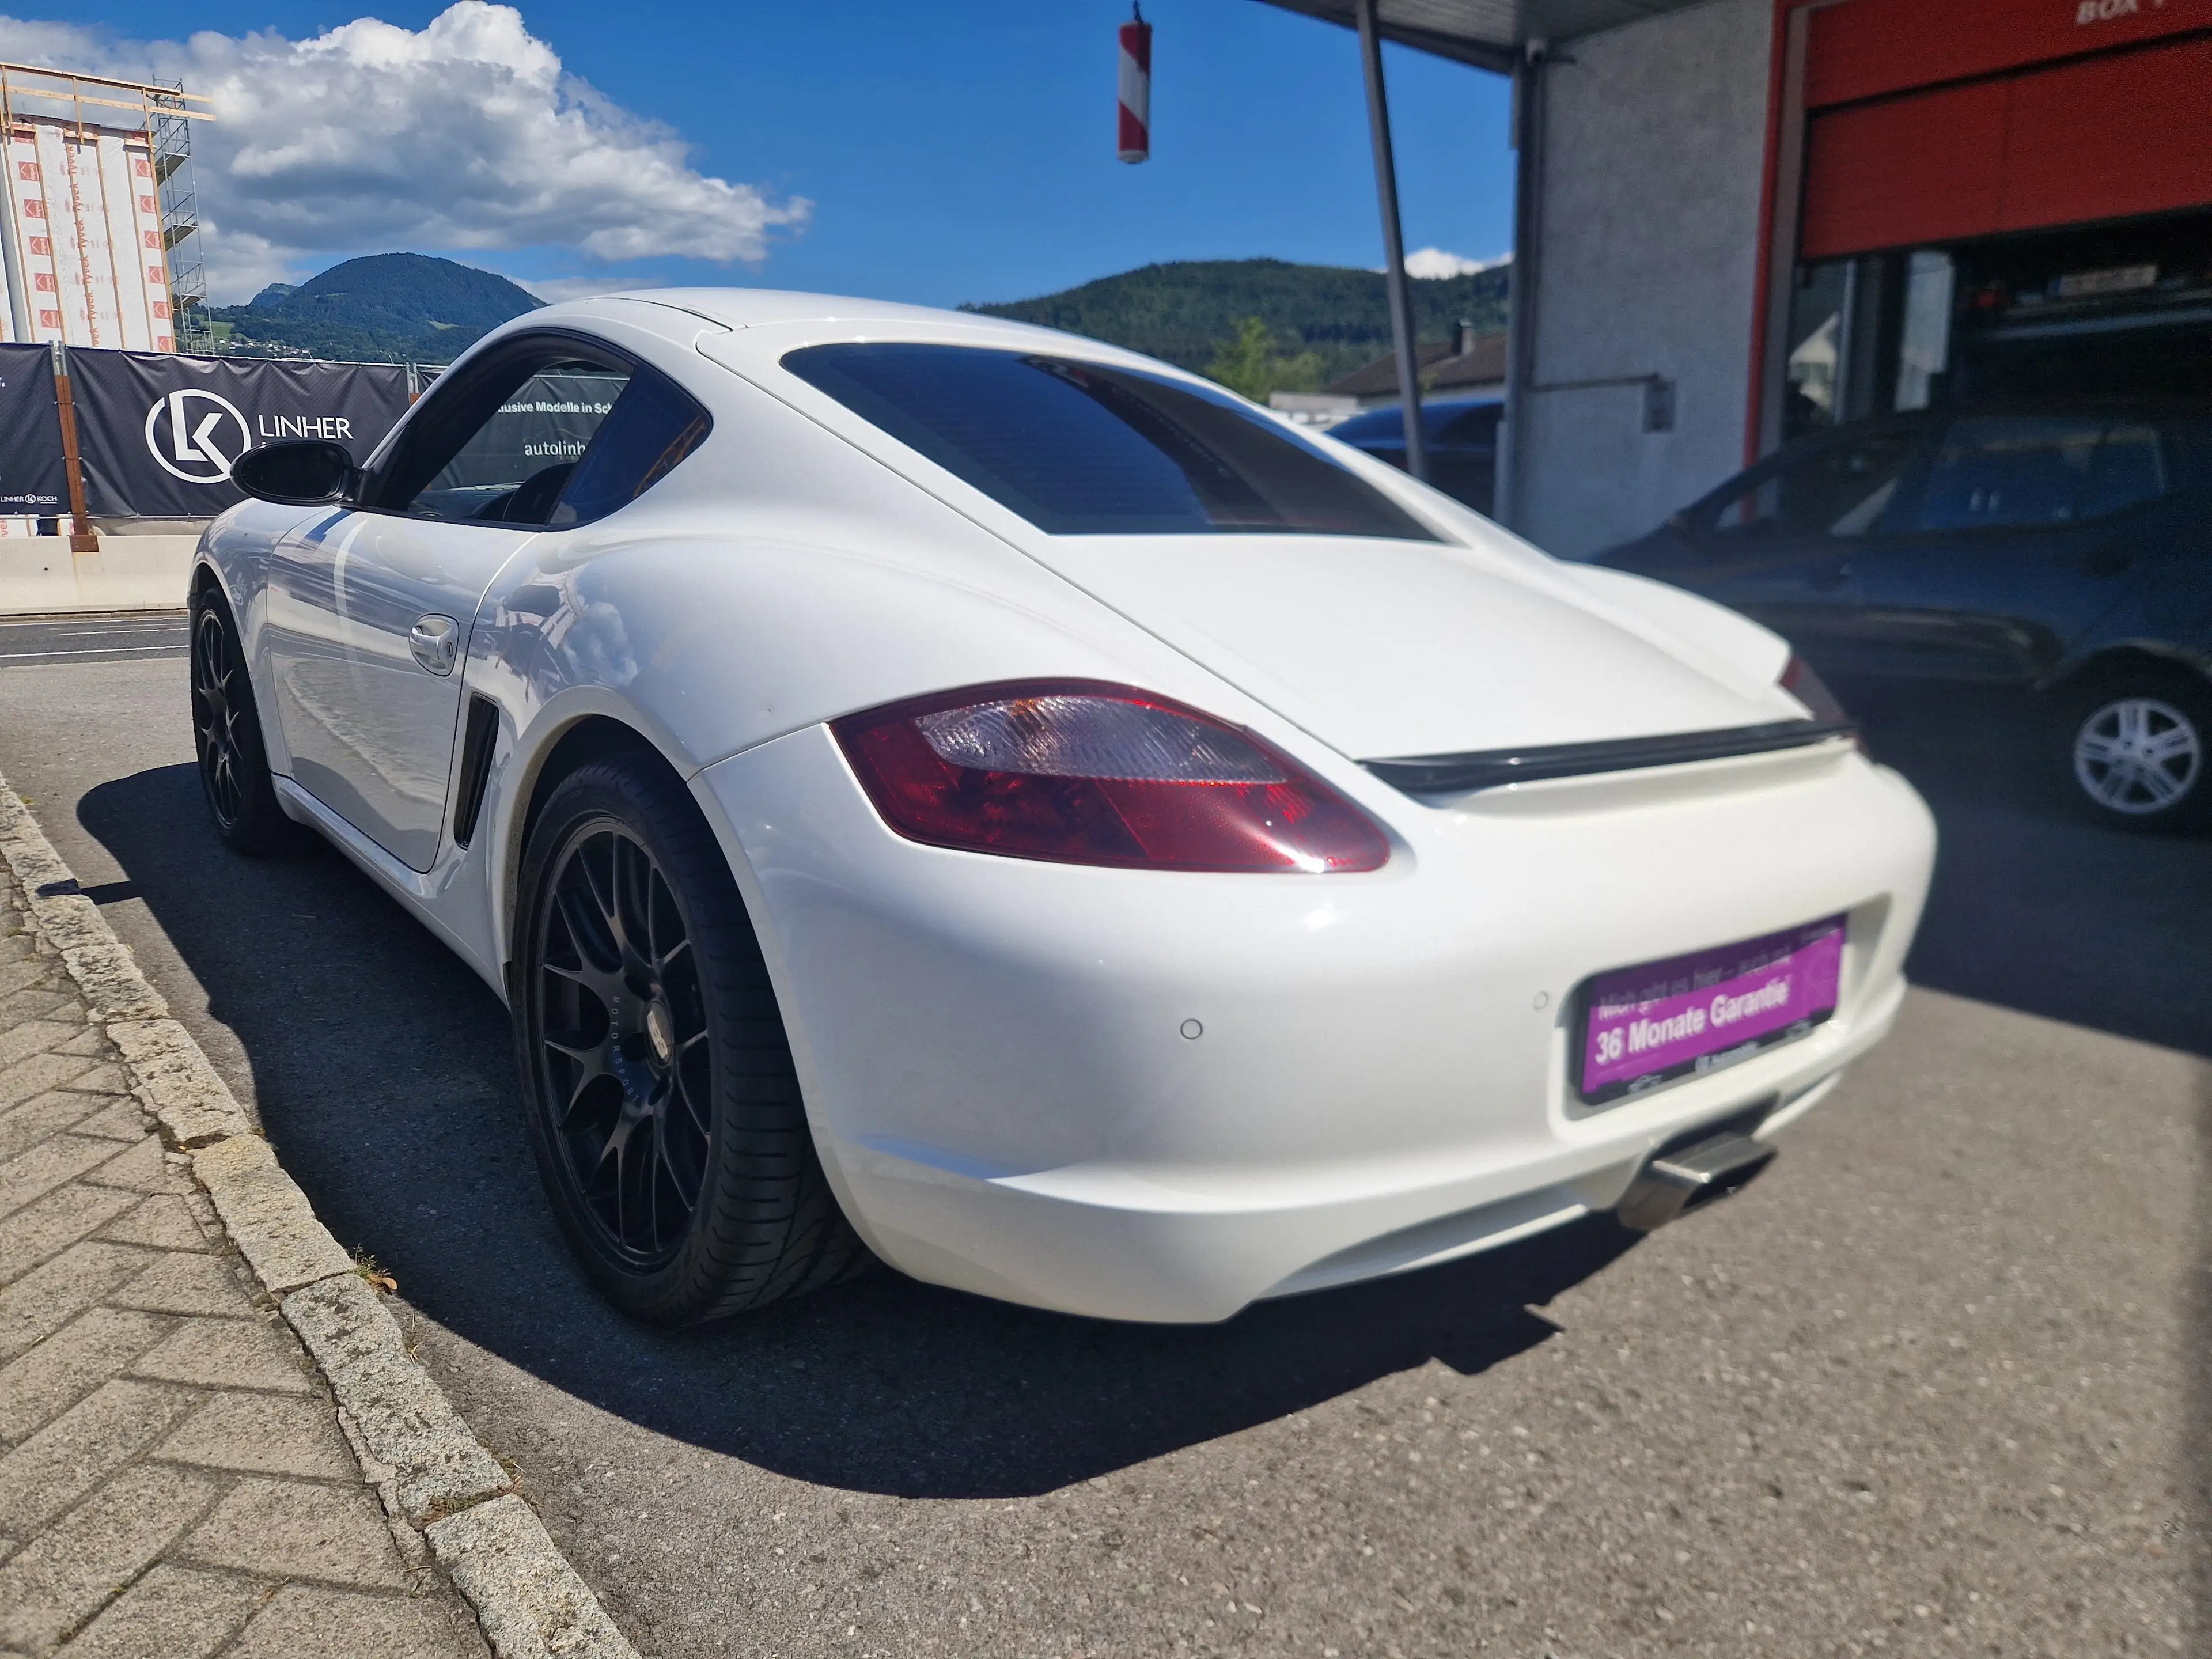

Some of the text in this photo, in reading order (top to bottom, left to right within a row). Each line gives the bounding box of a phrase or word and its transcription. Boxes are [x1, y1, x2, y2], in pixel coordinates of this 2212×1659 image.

[2075, 0, 2137, 24] BOX
[536, 401, 579, 413] Modelle
[581, 403, 592, 413] in
[258, 415, 354, 439] LINHER
[1594, 1027, 1626, 1066] 36
[1627, 1006, 1709, 1054] Monate
[611, 996, 639, 1101] MOTORSPORT
